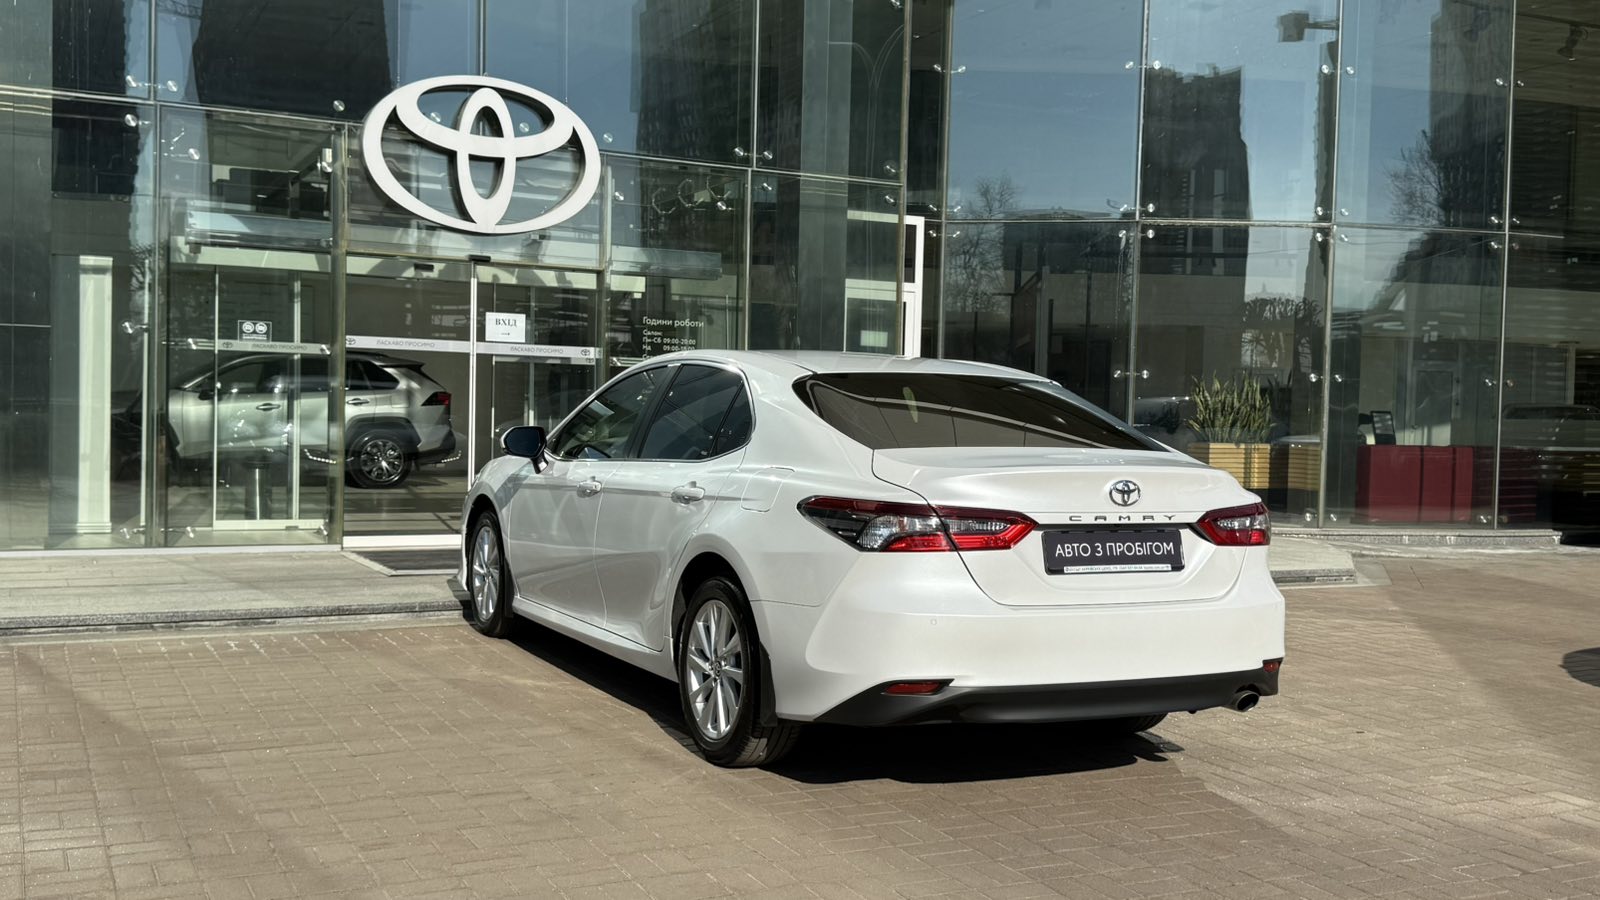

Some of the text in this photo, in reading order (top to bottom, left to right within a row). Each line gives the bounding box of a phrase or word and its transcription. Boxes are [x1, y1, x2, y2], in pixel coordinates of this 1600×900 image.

[495, 318, 517, 328] ВХІД
[642, 316, 704, 328] Години роботи
[404, 340, 435, 348] ПРОСИМО
[1069, 514, 1177, 522] CAMRY
[1054, 541, 1175, 557] АВТО З ПРОБІГОМ
